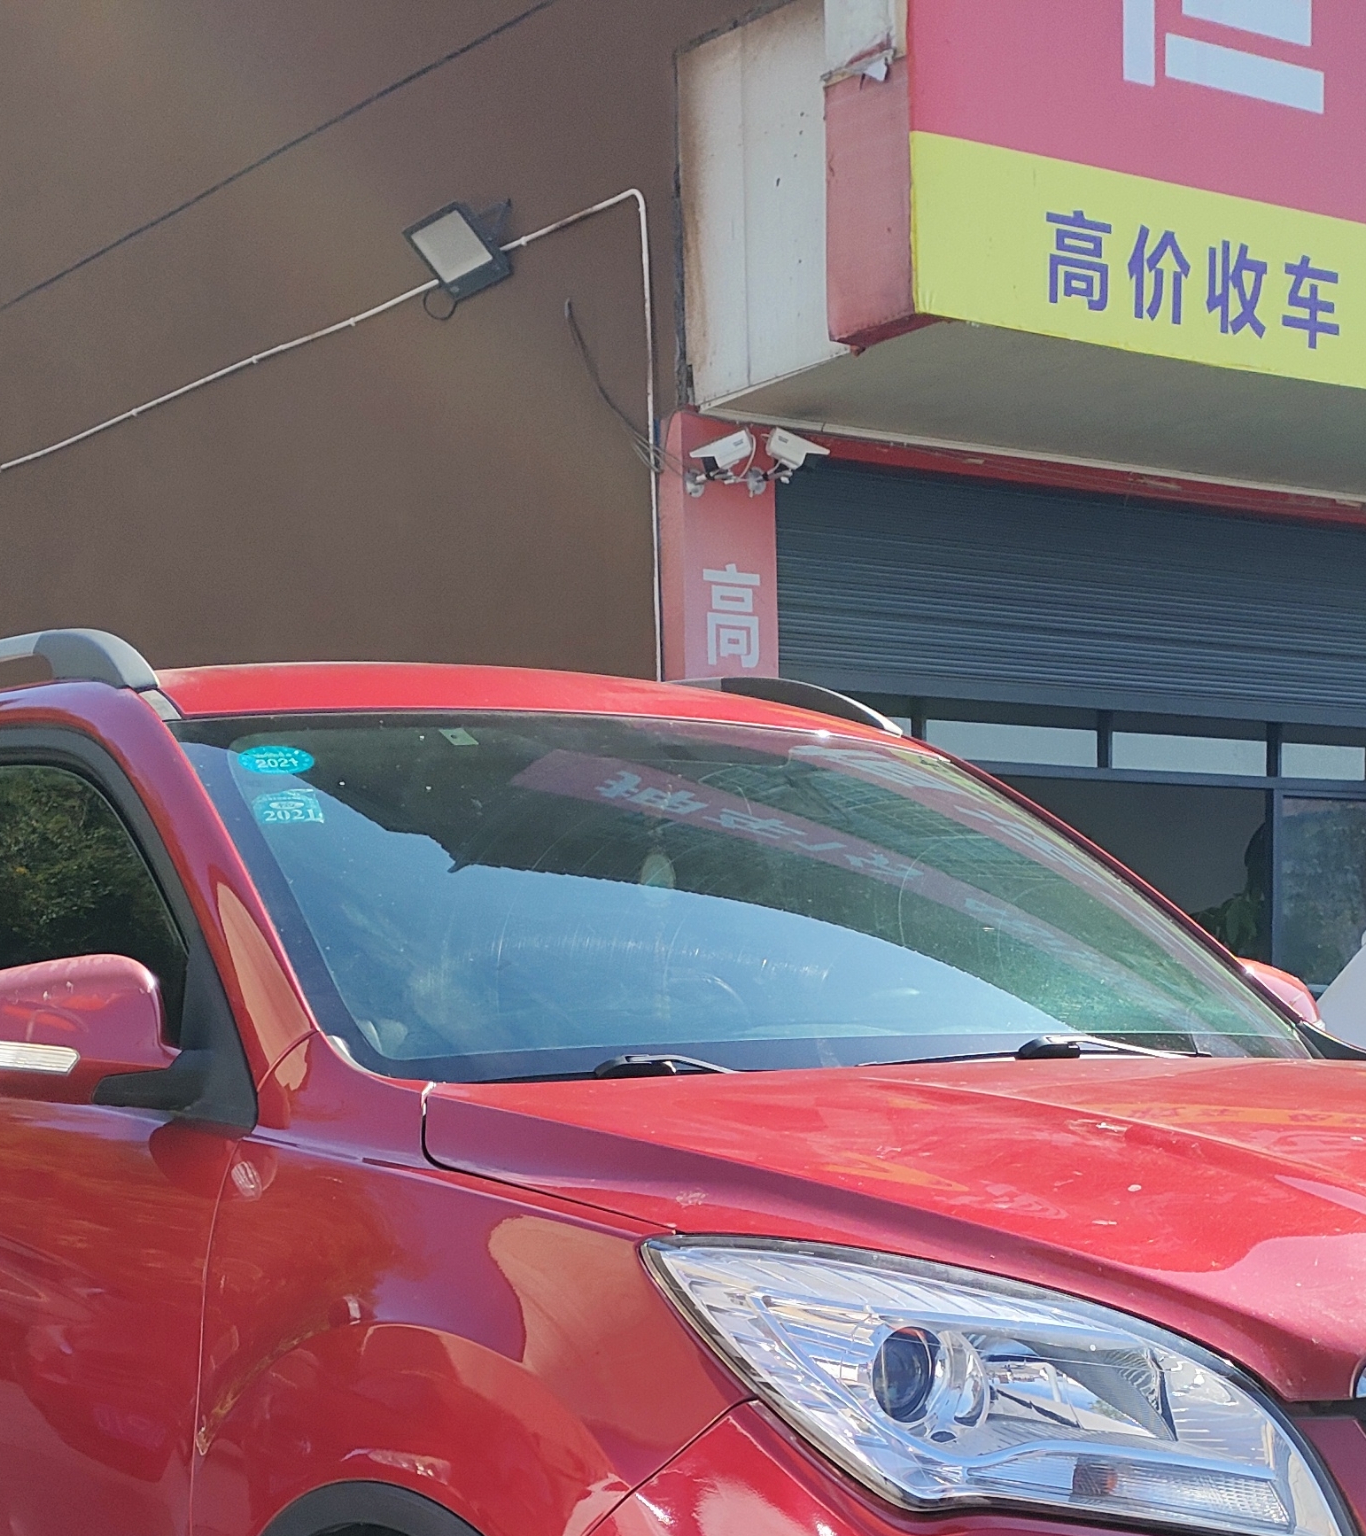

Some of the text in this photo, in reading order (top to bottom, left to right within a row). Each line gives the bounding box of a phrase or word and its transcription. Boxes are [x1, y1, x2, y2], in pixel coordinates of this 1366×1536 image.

[1046, 210, 1340, 349] 高价收车
[703, 563, 760, 668] 高
[263, 808, 319, 821] 2021
